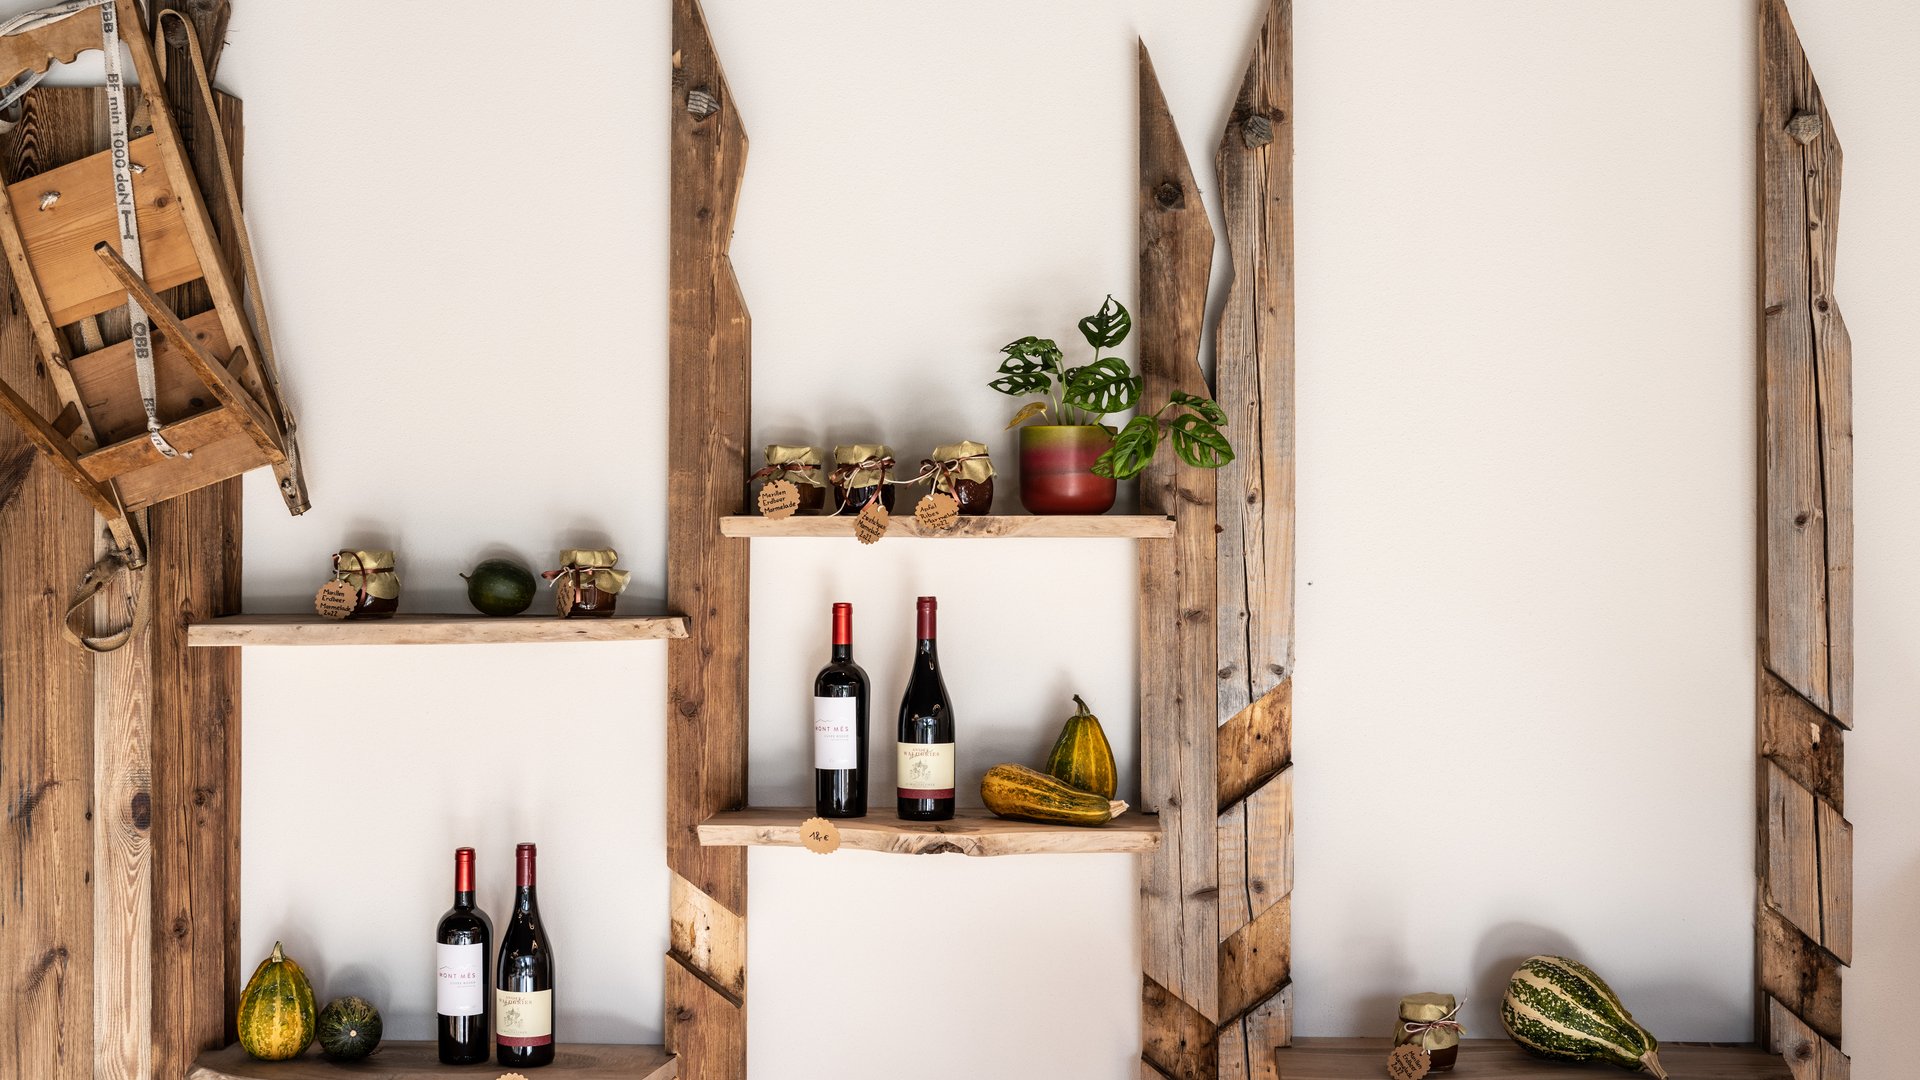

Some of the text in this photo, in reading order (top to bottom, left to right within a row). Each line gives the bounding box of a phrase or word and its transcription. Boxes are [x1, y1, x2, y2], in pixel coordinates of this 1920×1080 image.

[107, 73, 131, 206] BF min 1000 daN
